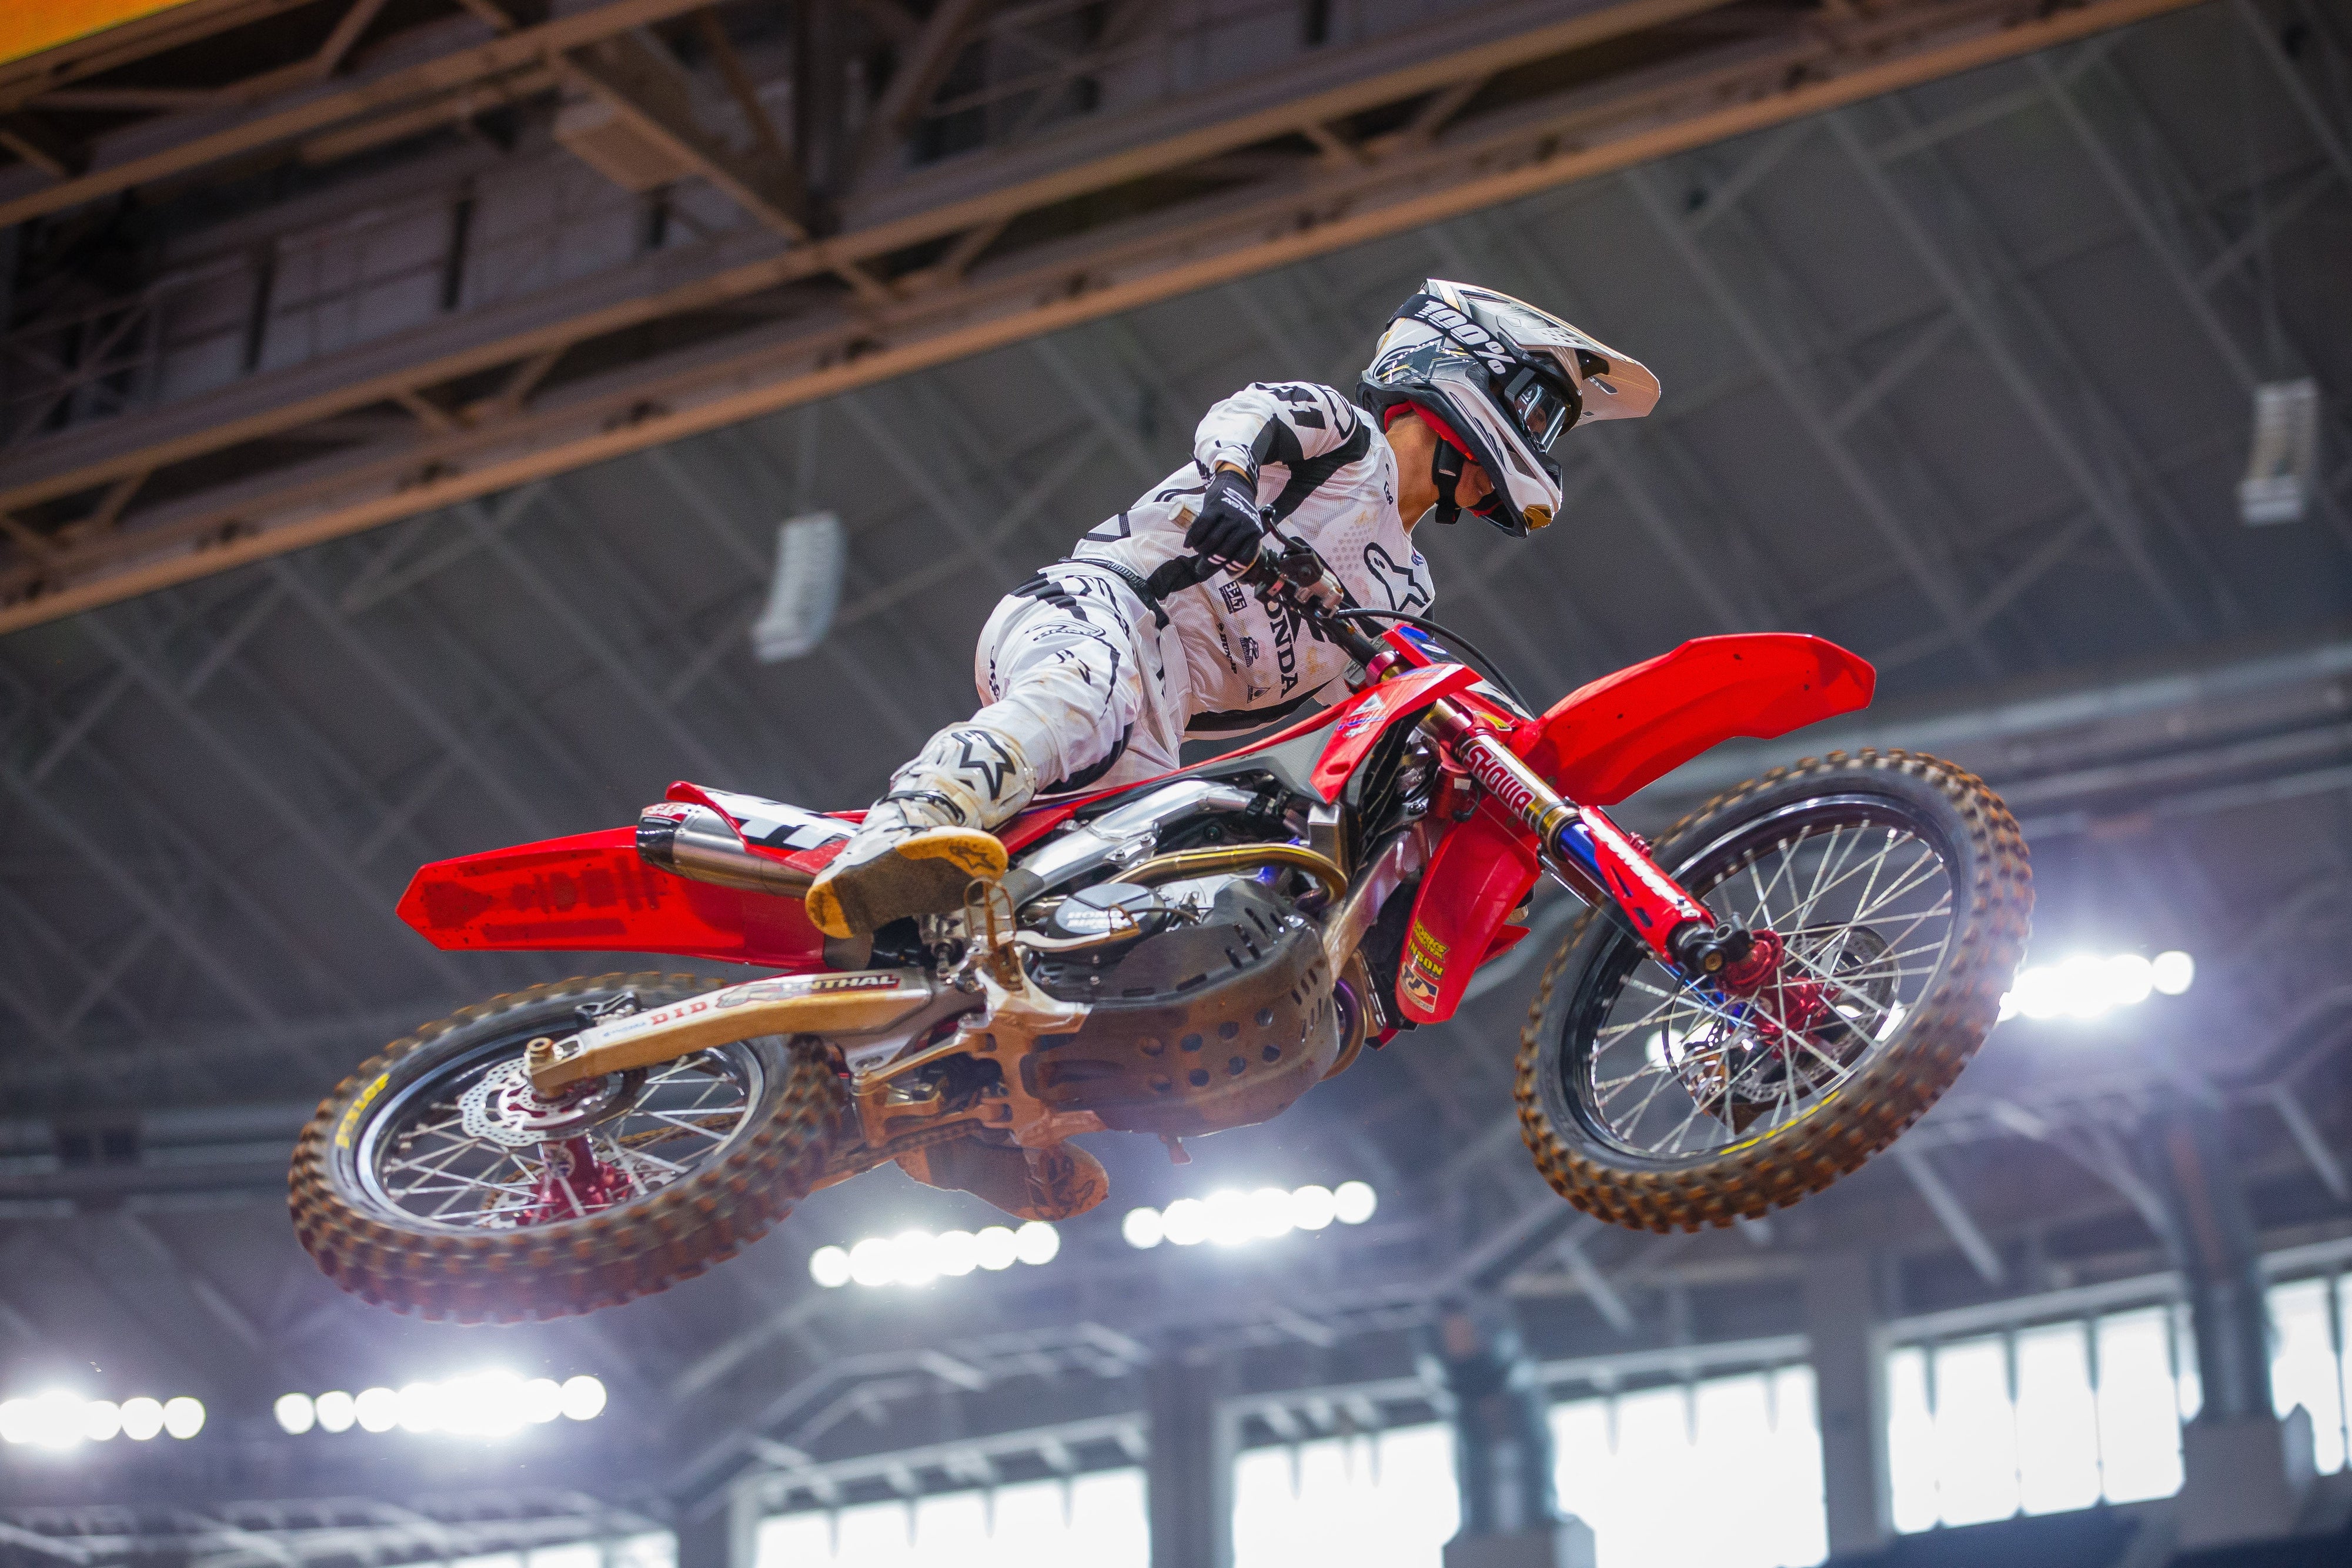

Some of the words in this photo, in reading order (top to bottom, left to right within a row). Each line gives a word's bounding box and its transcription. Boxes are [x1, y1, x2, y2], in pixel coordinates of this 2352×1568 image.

[1414, 299, 1517, 375] 100%
[1264, 600, 1298, 700] ONDA
[1462, 744, 1537, 821] SHOWA
